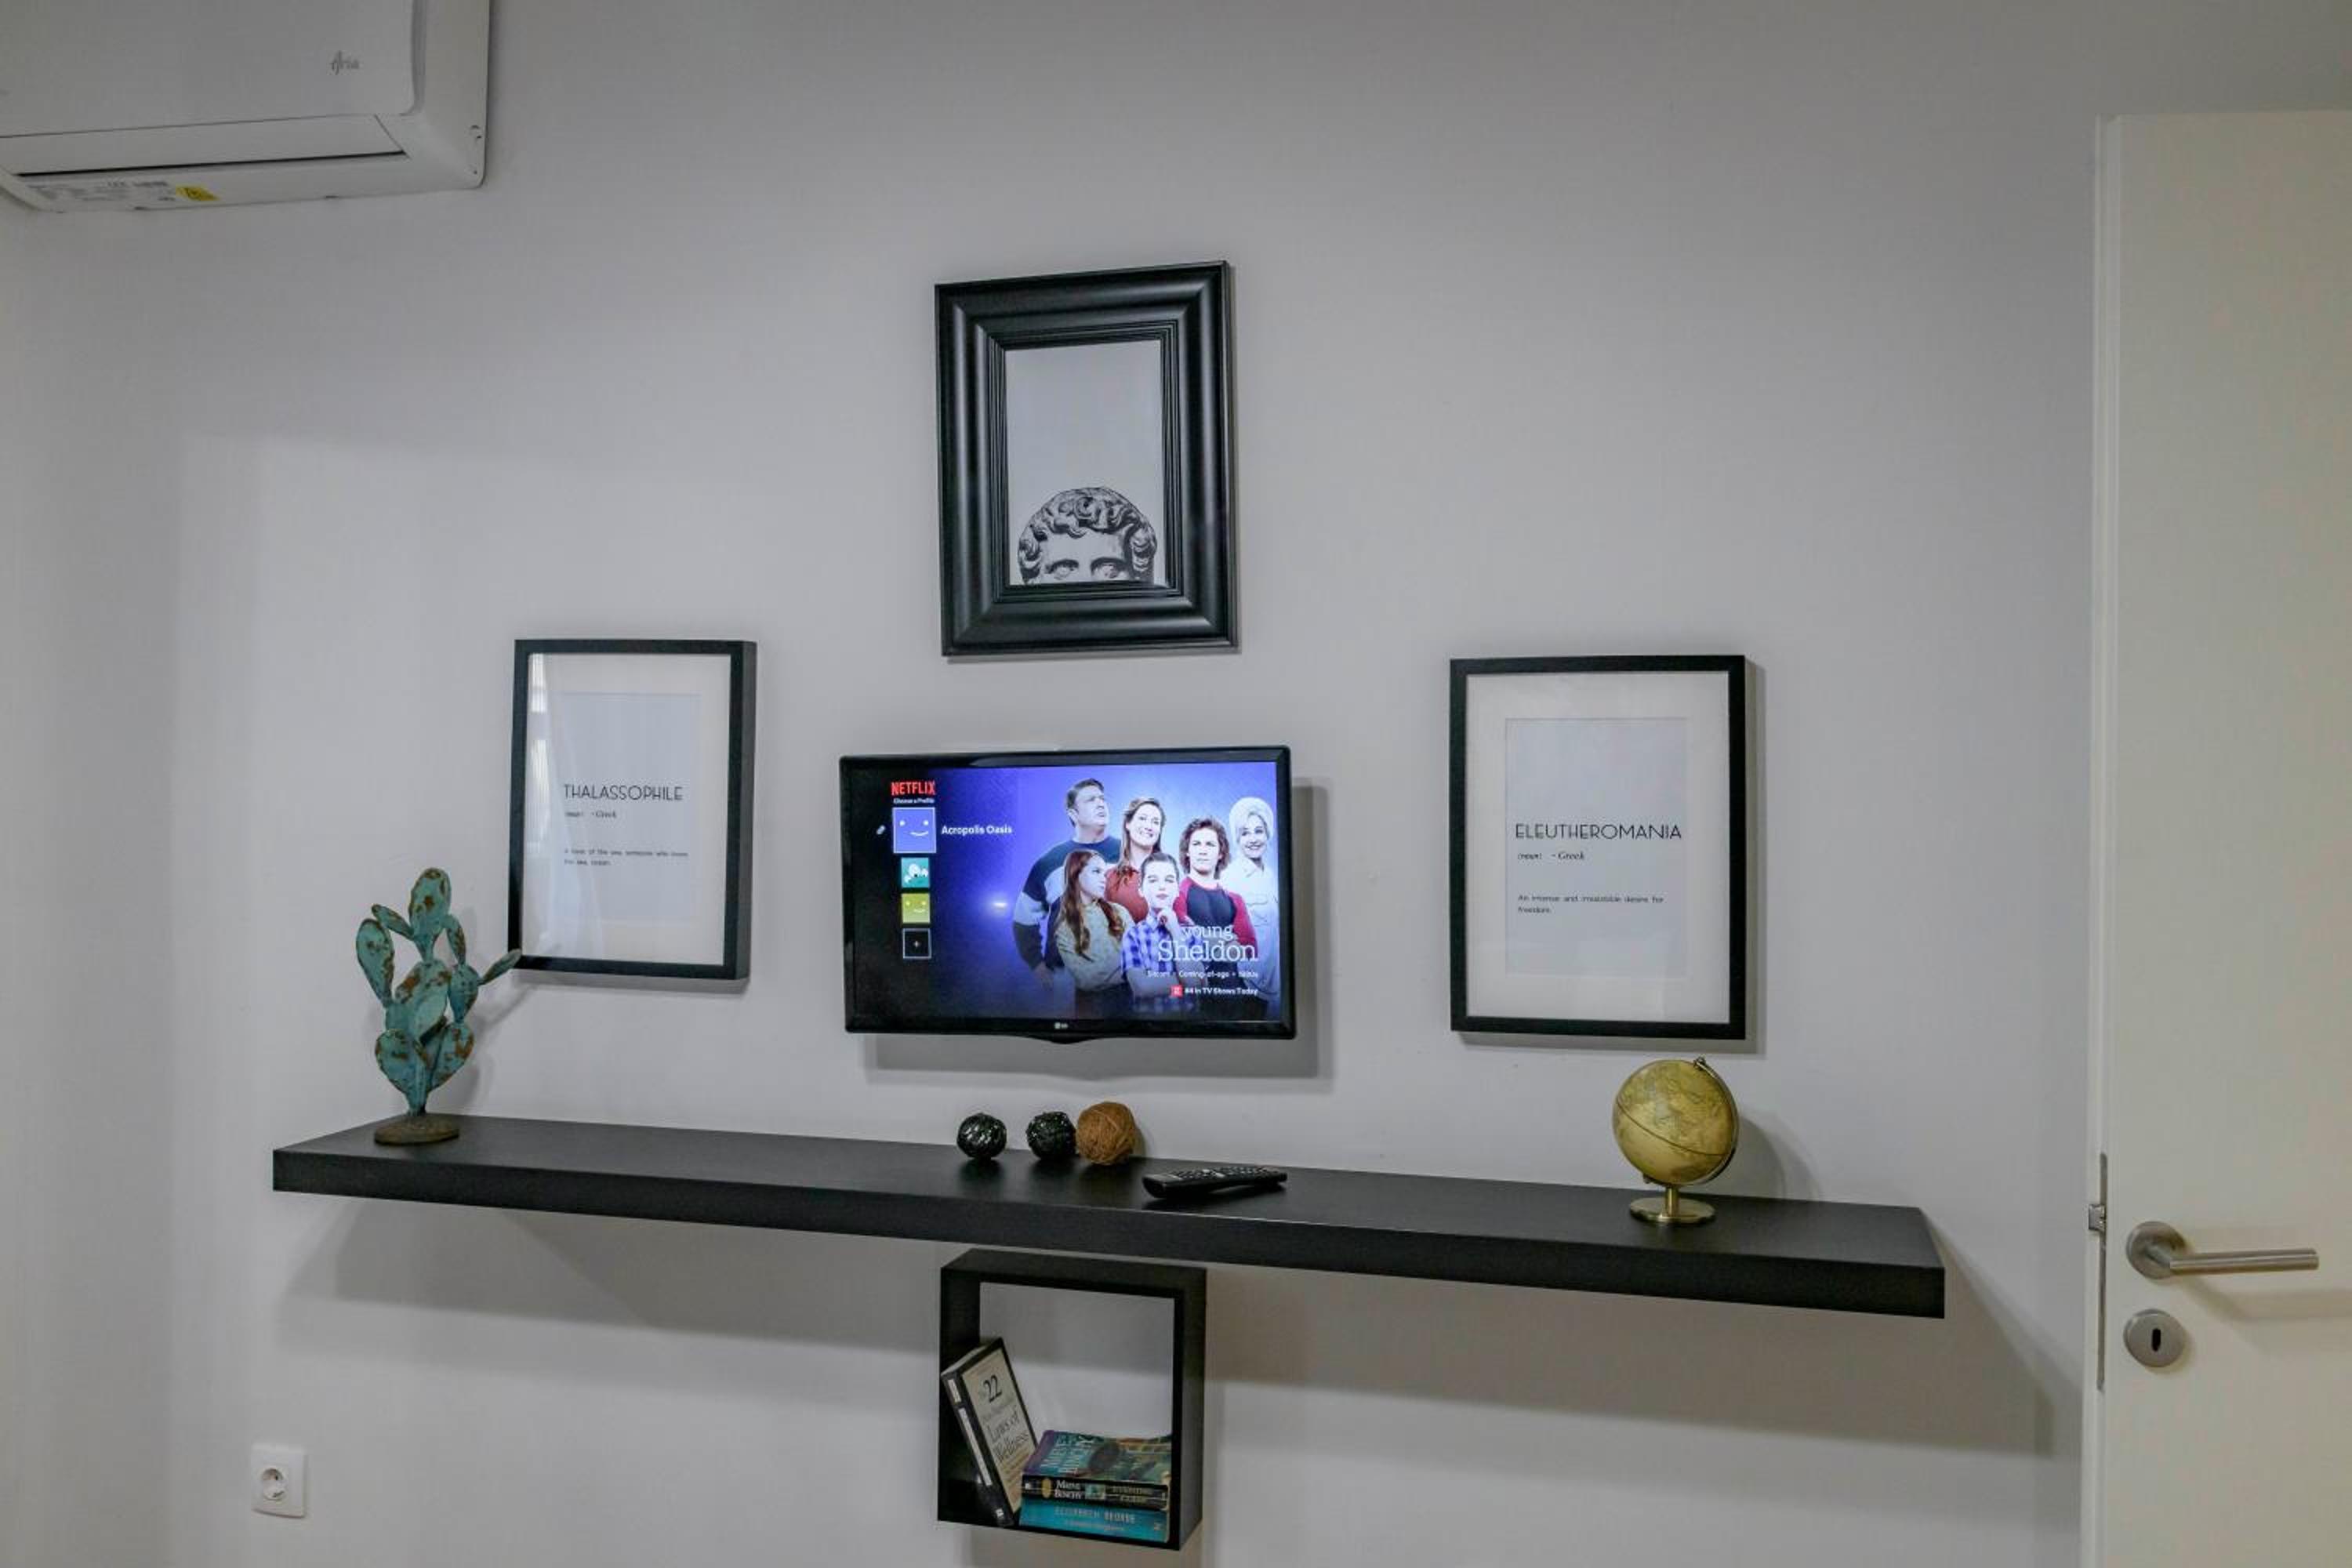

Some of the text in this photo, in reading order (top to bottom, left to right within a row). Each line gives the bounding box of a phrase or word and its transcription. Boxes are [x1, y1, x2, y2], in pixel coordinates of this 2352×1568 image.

[564, 783, 684, 801] THALASSOPHILE
[891, 780, 936, 796] NETFLIX
[941, 824, 1013, 836] Acropolis Oasis
[1515, 823, 1682, 840] ELEUTHEROMANIA
[1181, 924, 1235, 941] young
[1158, 940, 1259, 963] Sheldon
[982, 1374, 1003, 1403] 22
